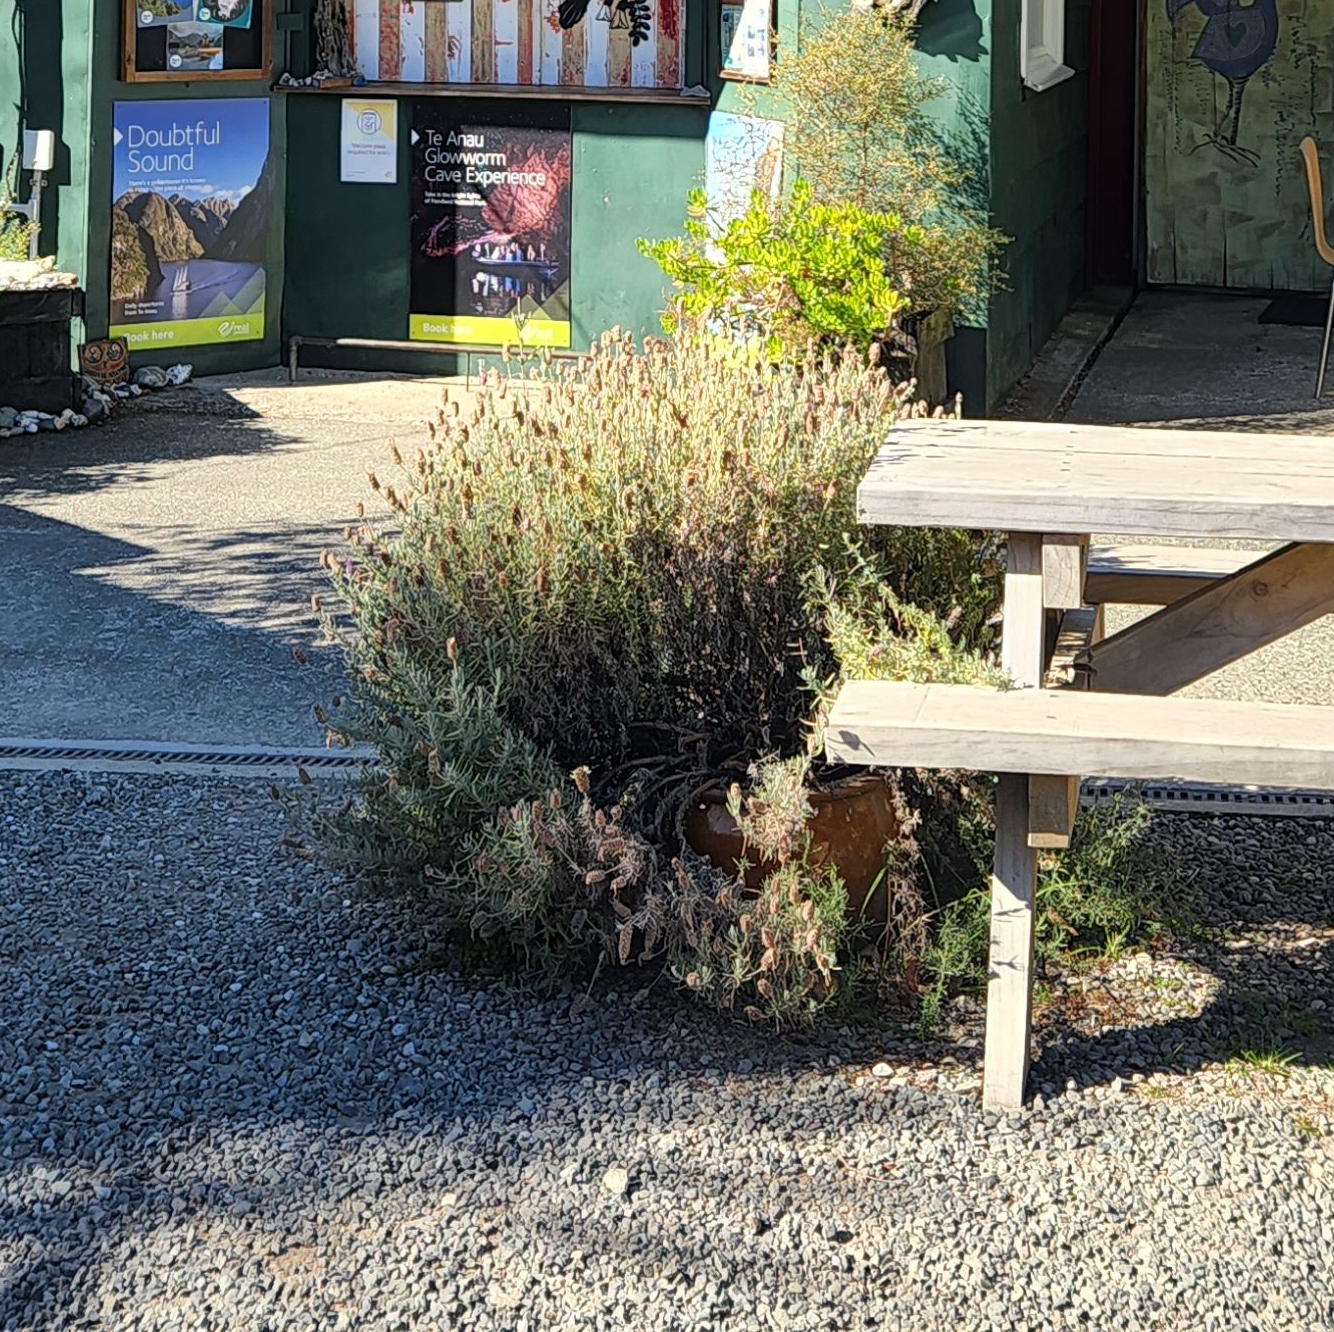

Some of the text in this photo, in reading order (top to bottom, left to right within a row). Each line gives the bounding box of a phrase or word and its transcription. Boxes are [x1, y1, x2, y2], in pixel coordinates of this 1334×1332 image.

[128, 120, 220, 148] Doubtful
[424, 129, 484, 148] Te Anau
[127, 147, 194, 173] Sound
[424, 147, 507, 166] Glowworm
[424, 165, 547, 188] Cave Experience
[151, 329, 175, 341] here
[422, 323, 449, 334] Book
